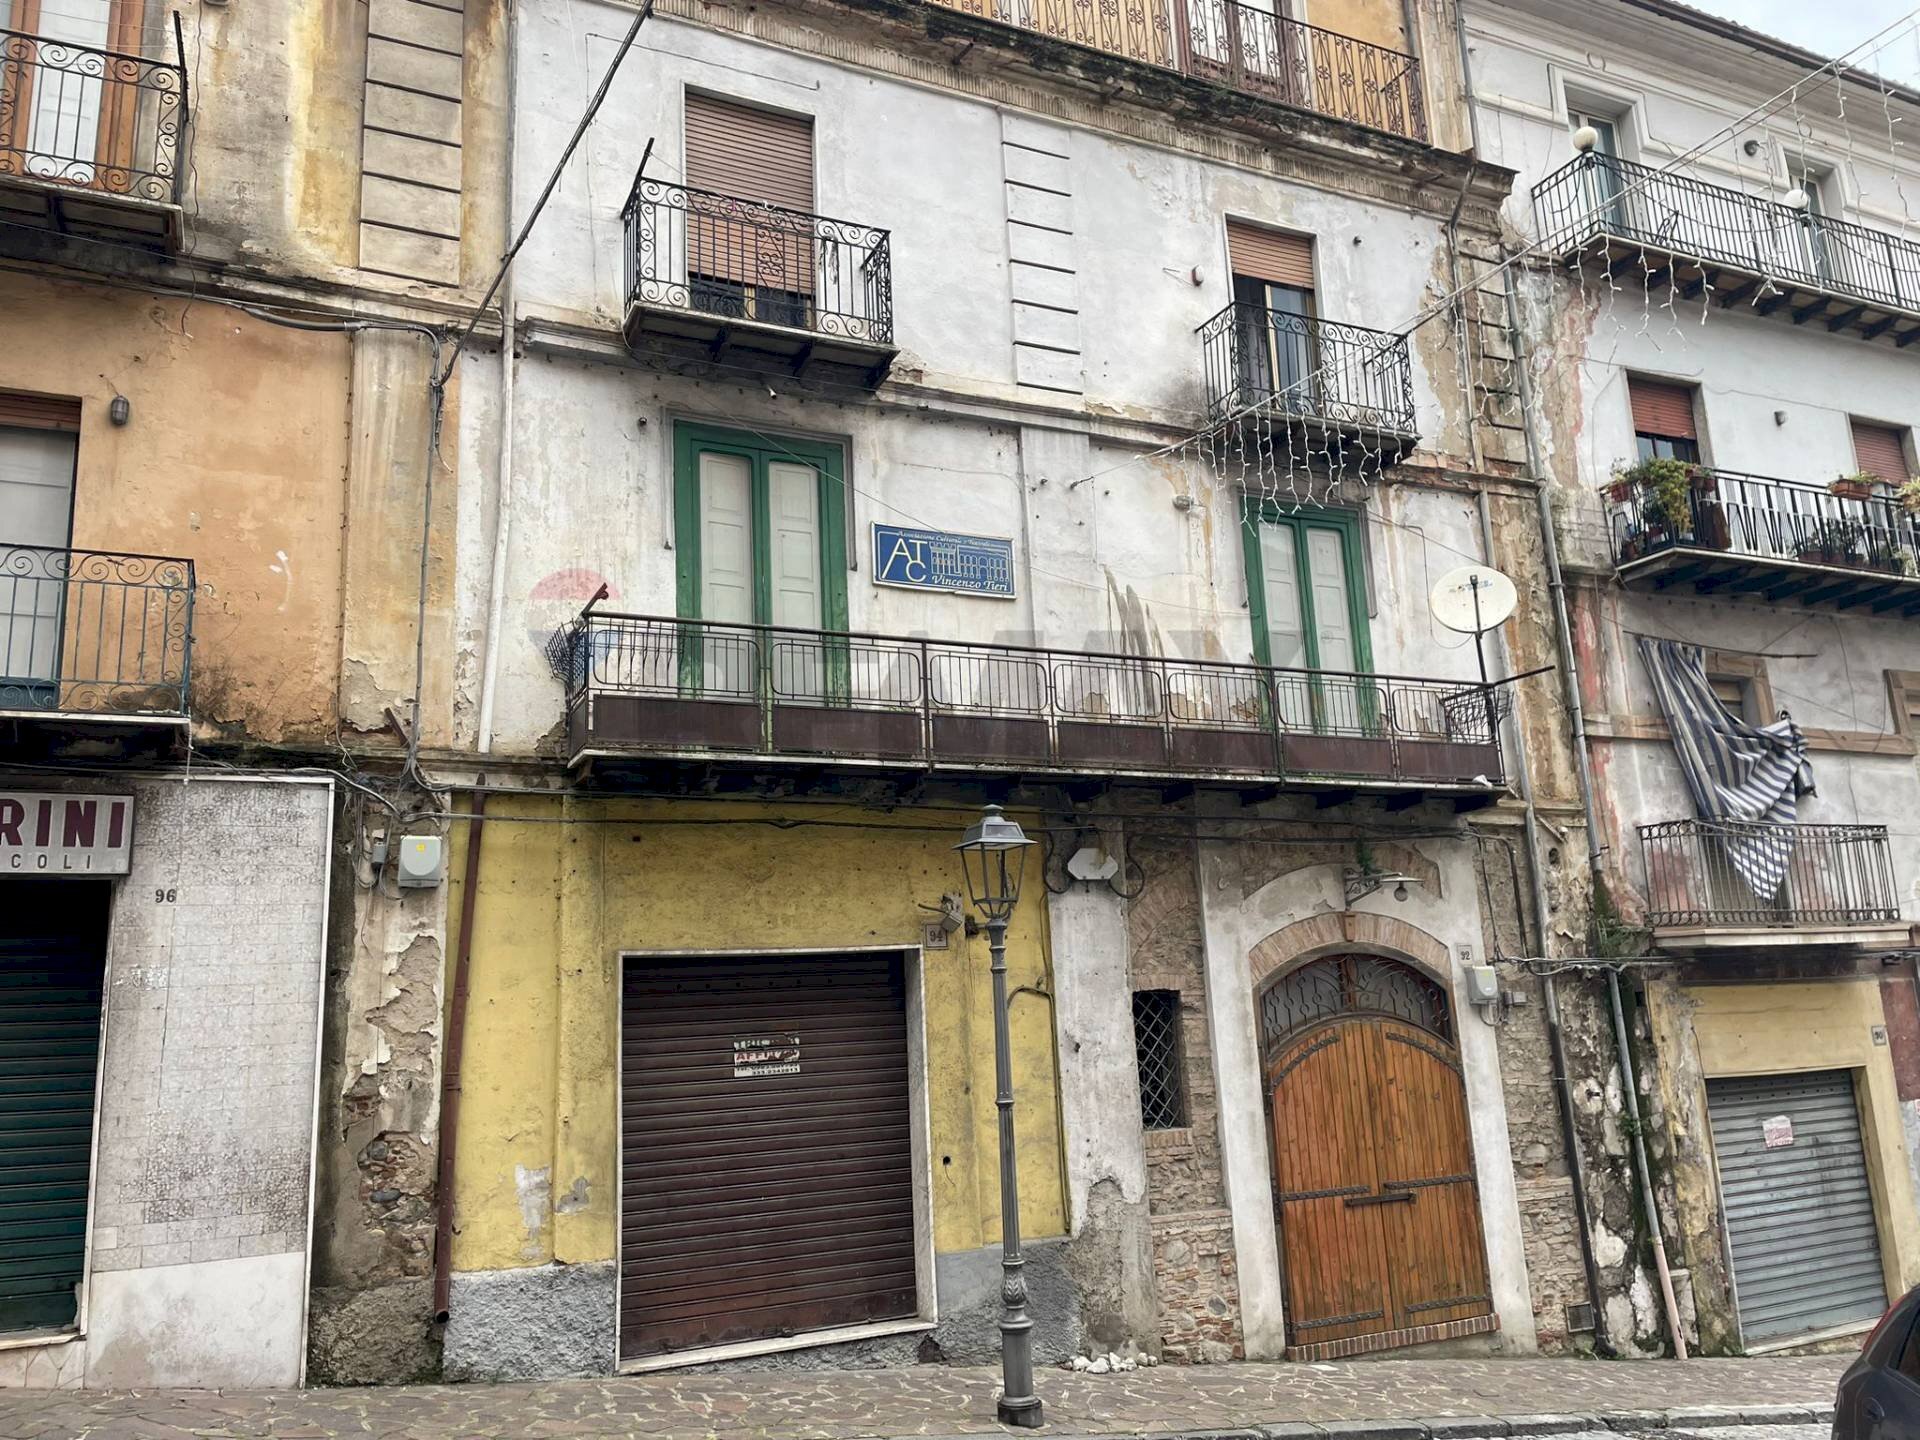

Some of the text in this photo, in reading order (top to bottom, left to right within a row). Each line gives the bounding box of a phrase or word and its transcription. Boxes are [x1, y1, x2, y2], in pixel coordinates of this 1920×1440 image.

[931, 574, 1008, 592] Vincenzo Tieri
[0, 799, 125, 848] RINI
[11, 854, 91, 869] COLI
[155, 889, 176, 903] 96
[1460, 950, 1471, 960] 92
